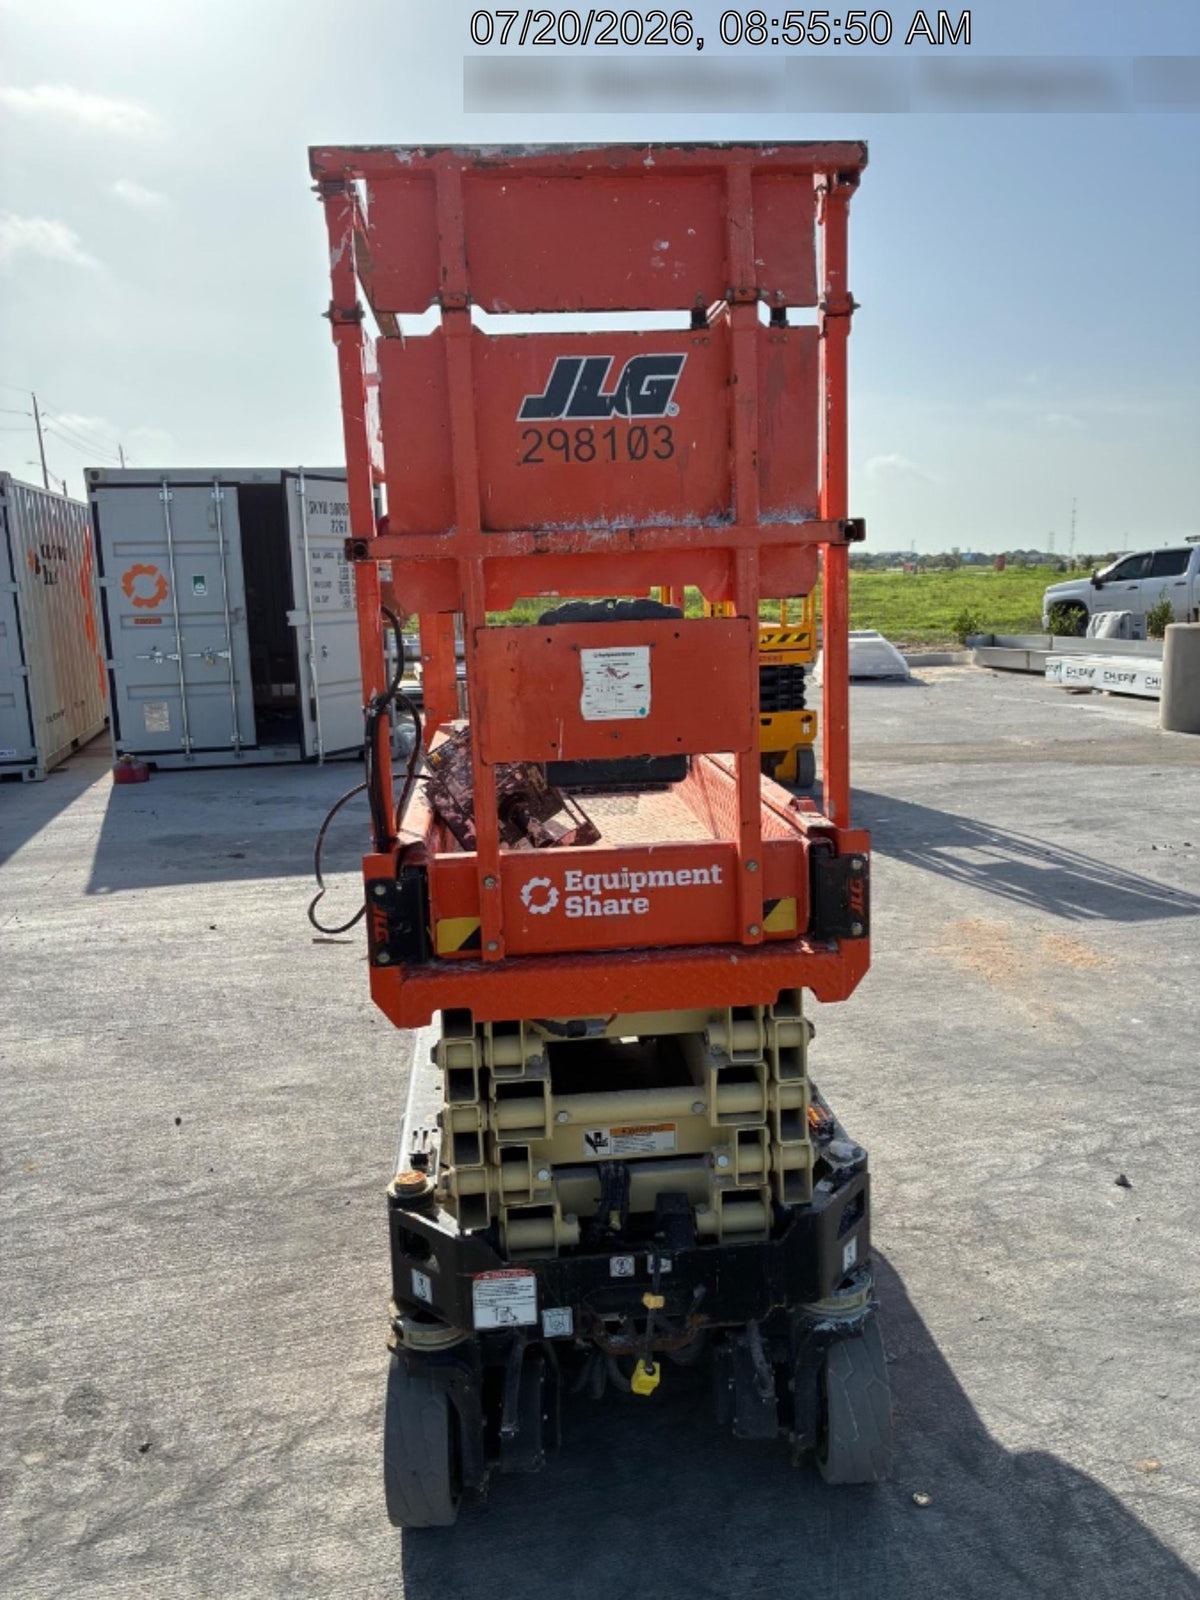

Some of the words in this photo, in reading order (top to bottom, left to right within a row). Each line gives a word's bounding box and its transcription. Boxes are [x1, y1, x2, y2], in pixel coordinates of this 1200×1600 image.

[516, 353, 688, 422] JLG
[521, 425, 675, 464] 298103
[565, 864, 723, 894] Equipment
[565, 895, 650, 918] Share
